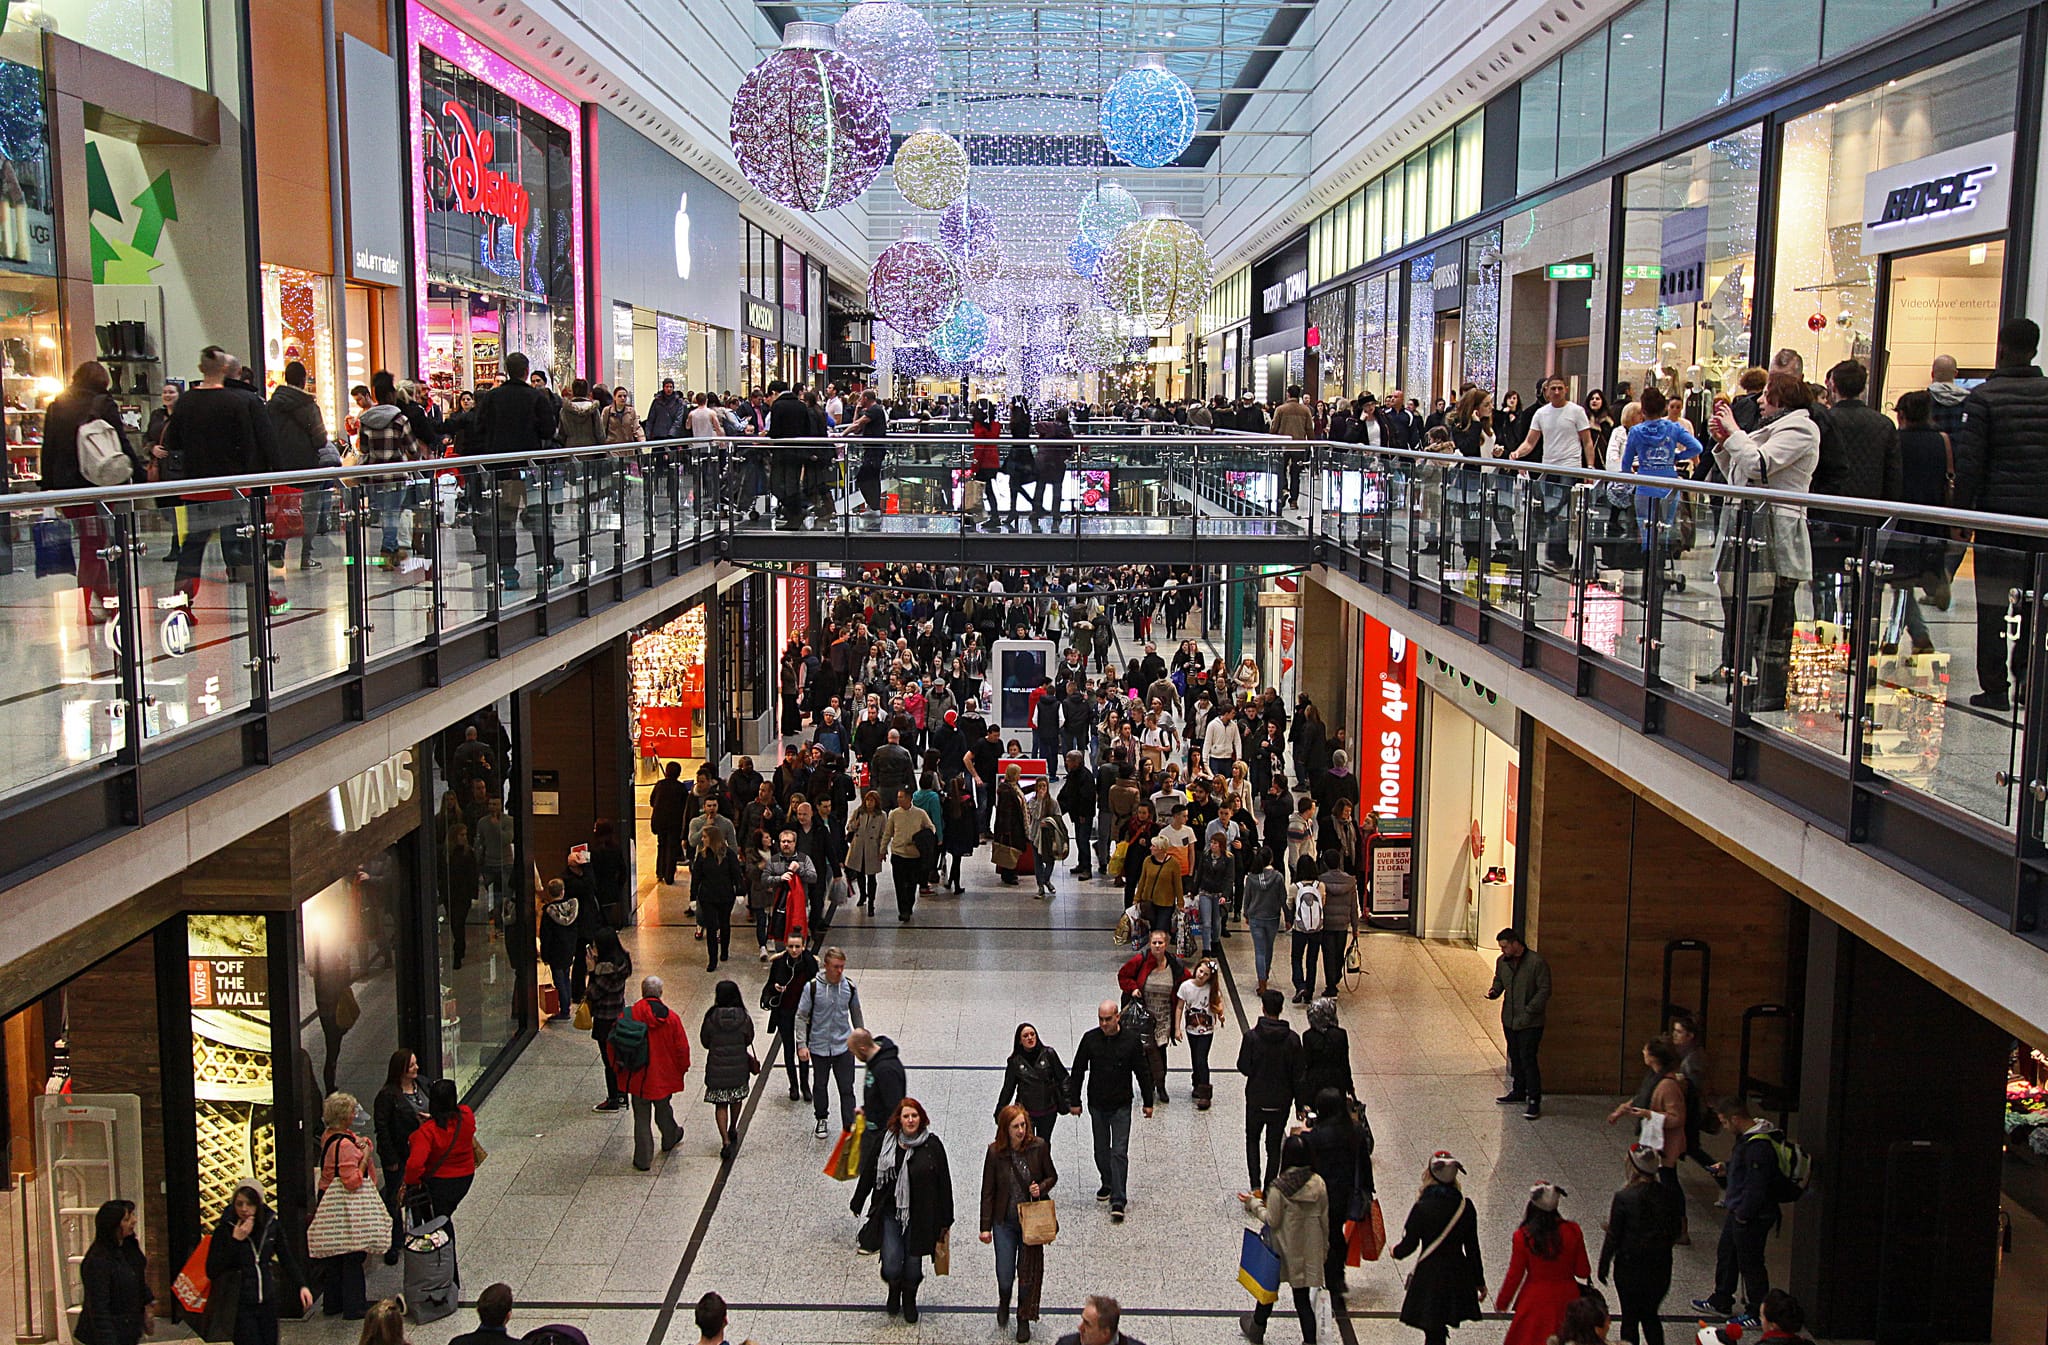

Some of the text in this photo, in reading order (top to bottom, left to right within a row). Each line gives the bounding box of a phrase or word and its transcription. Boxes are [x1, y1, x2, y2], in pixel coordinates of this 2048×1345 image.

[1867, 165, 1995, 228] BOSE
[30, 224, 50, 244] UGG
[748, 301, 773, 332] MONSOON
[644, 726, 688, 738] SALE
[1373, 731, 1401, 818] hones
[341, 751, 414, 832] VANS
[216, 977, 245, 990] THE
